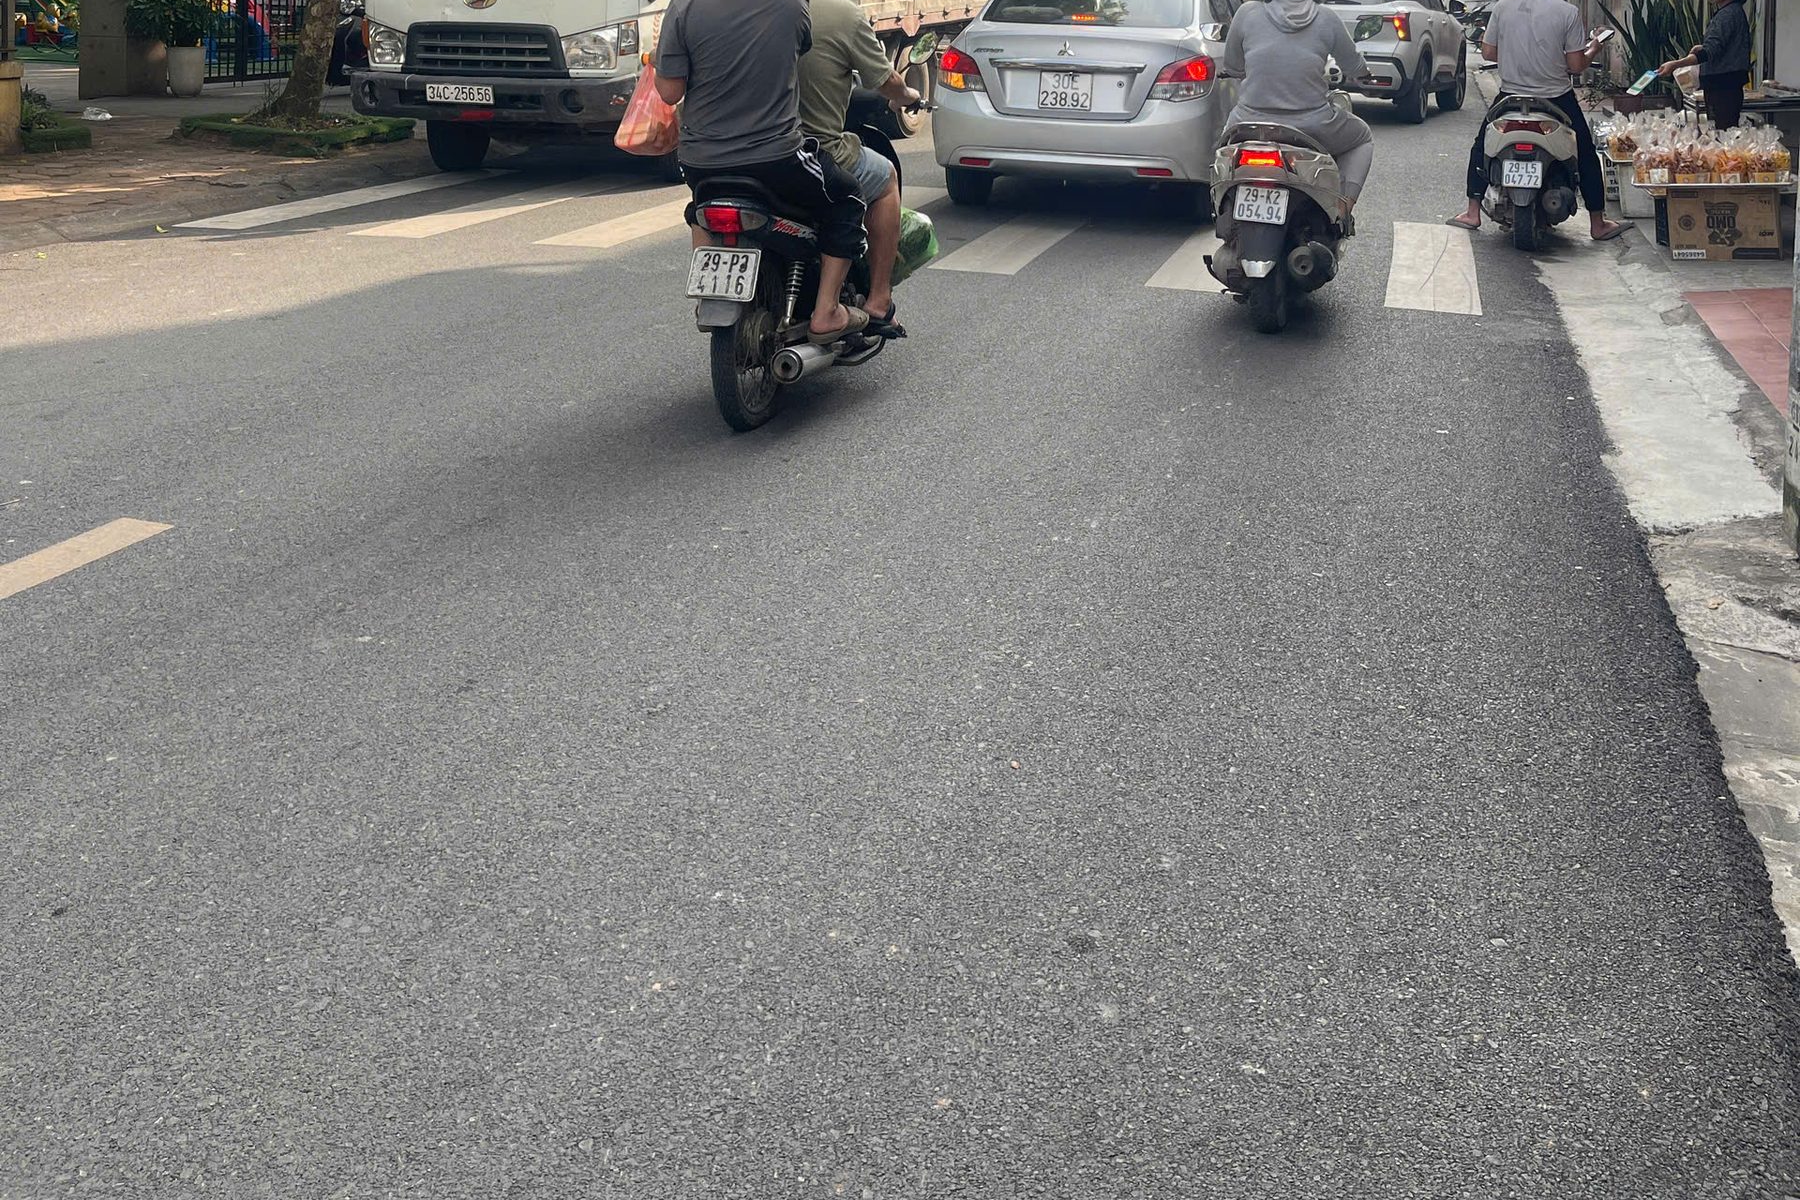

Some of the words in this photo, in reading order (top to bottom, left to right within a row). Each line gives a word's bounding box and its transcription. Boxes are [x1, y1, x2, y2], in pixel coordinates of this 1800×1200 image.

[1052, 73, 1080, 91] 30E
[427, 85, 492, 103] 34C-256.56
[1040, 90, 1089, 108] 238.92
[1508, 162, 1538, 174] 29-L5
[1504, 174, 1540, 186] 047.72
[1244, 188, 1281, 206] 29-K2
[1237, 203, 1282, 222] 054.94
[1705, 215, 1736, 229] OMO
